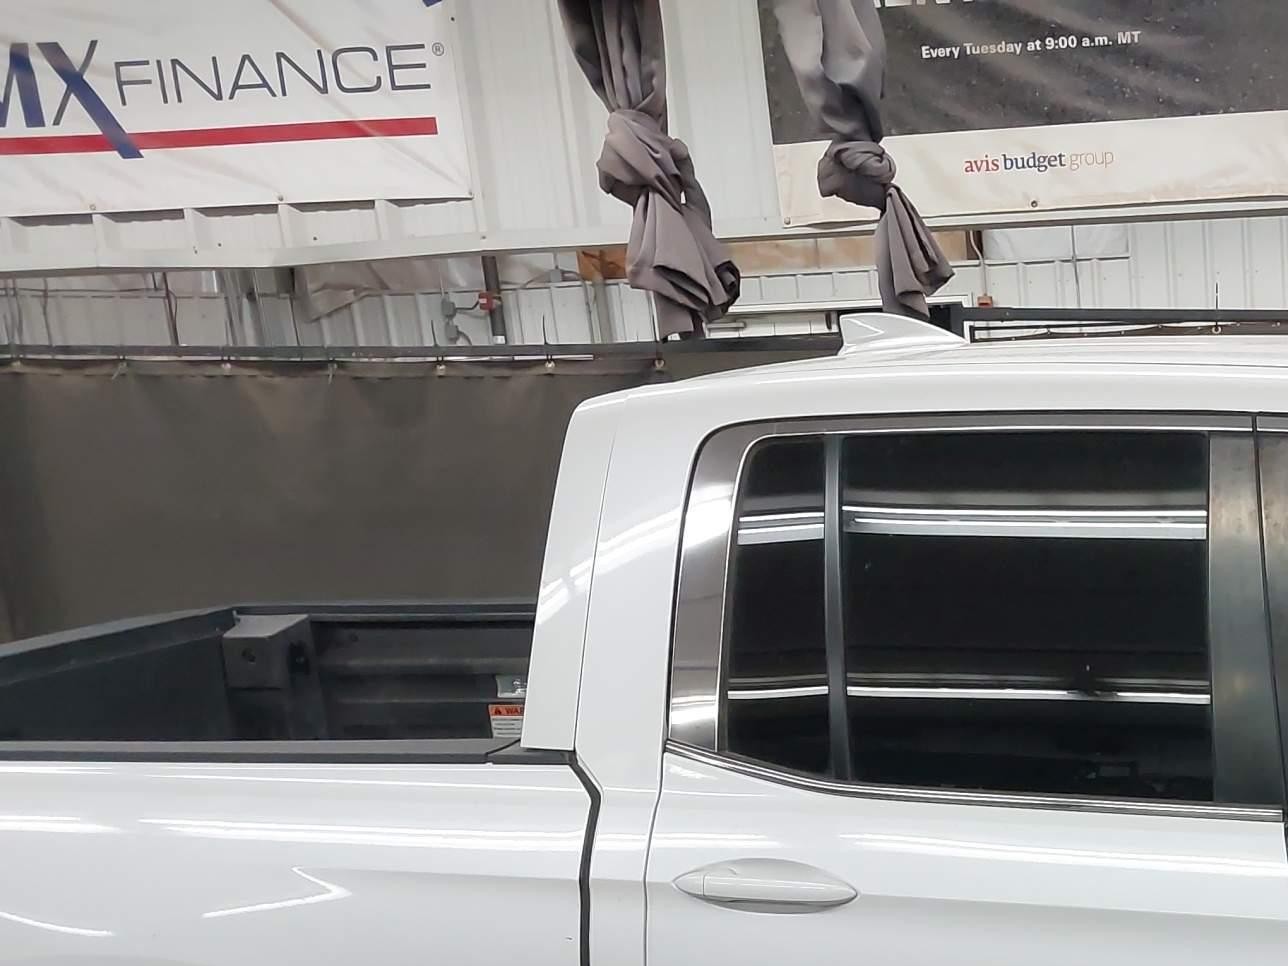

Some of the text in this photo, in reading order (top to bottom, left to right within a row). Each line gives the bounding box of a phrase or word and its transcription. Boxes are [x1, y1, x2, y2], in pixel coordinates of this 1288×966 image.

[921, 31, 1141, 59] Every Tuesday at 9:00 a.m. MT
[964, 151, 1114, 173] avis budget group
